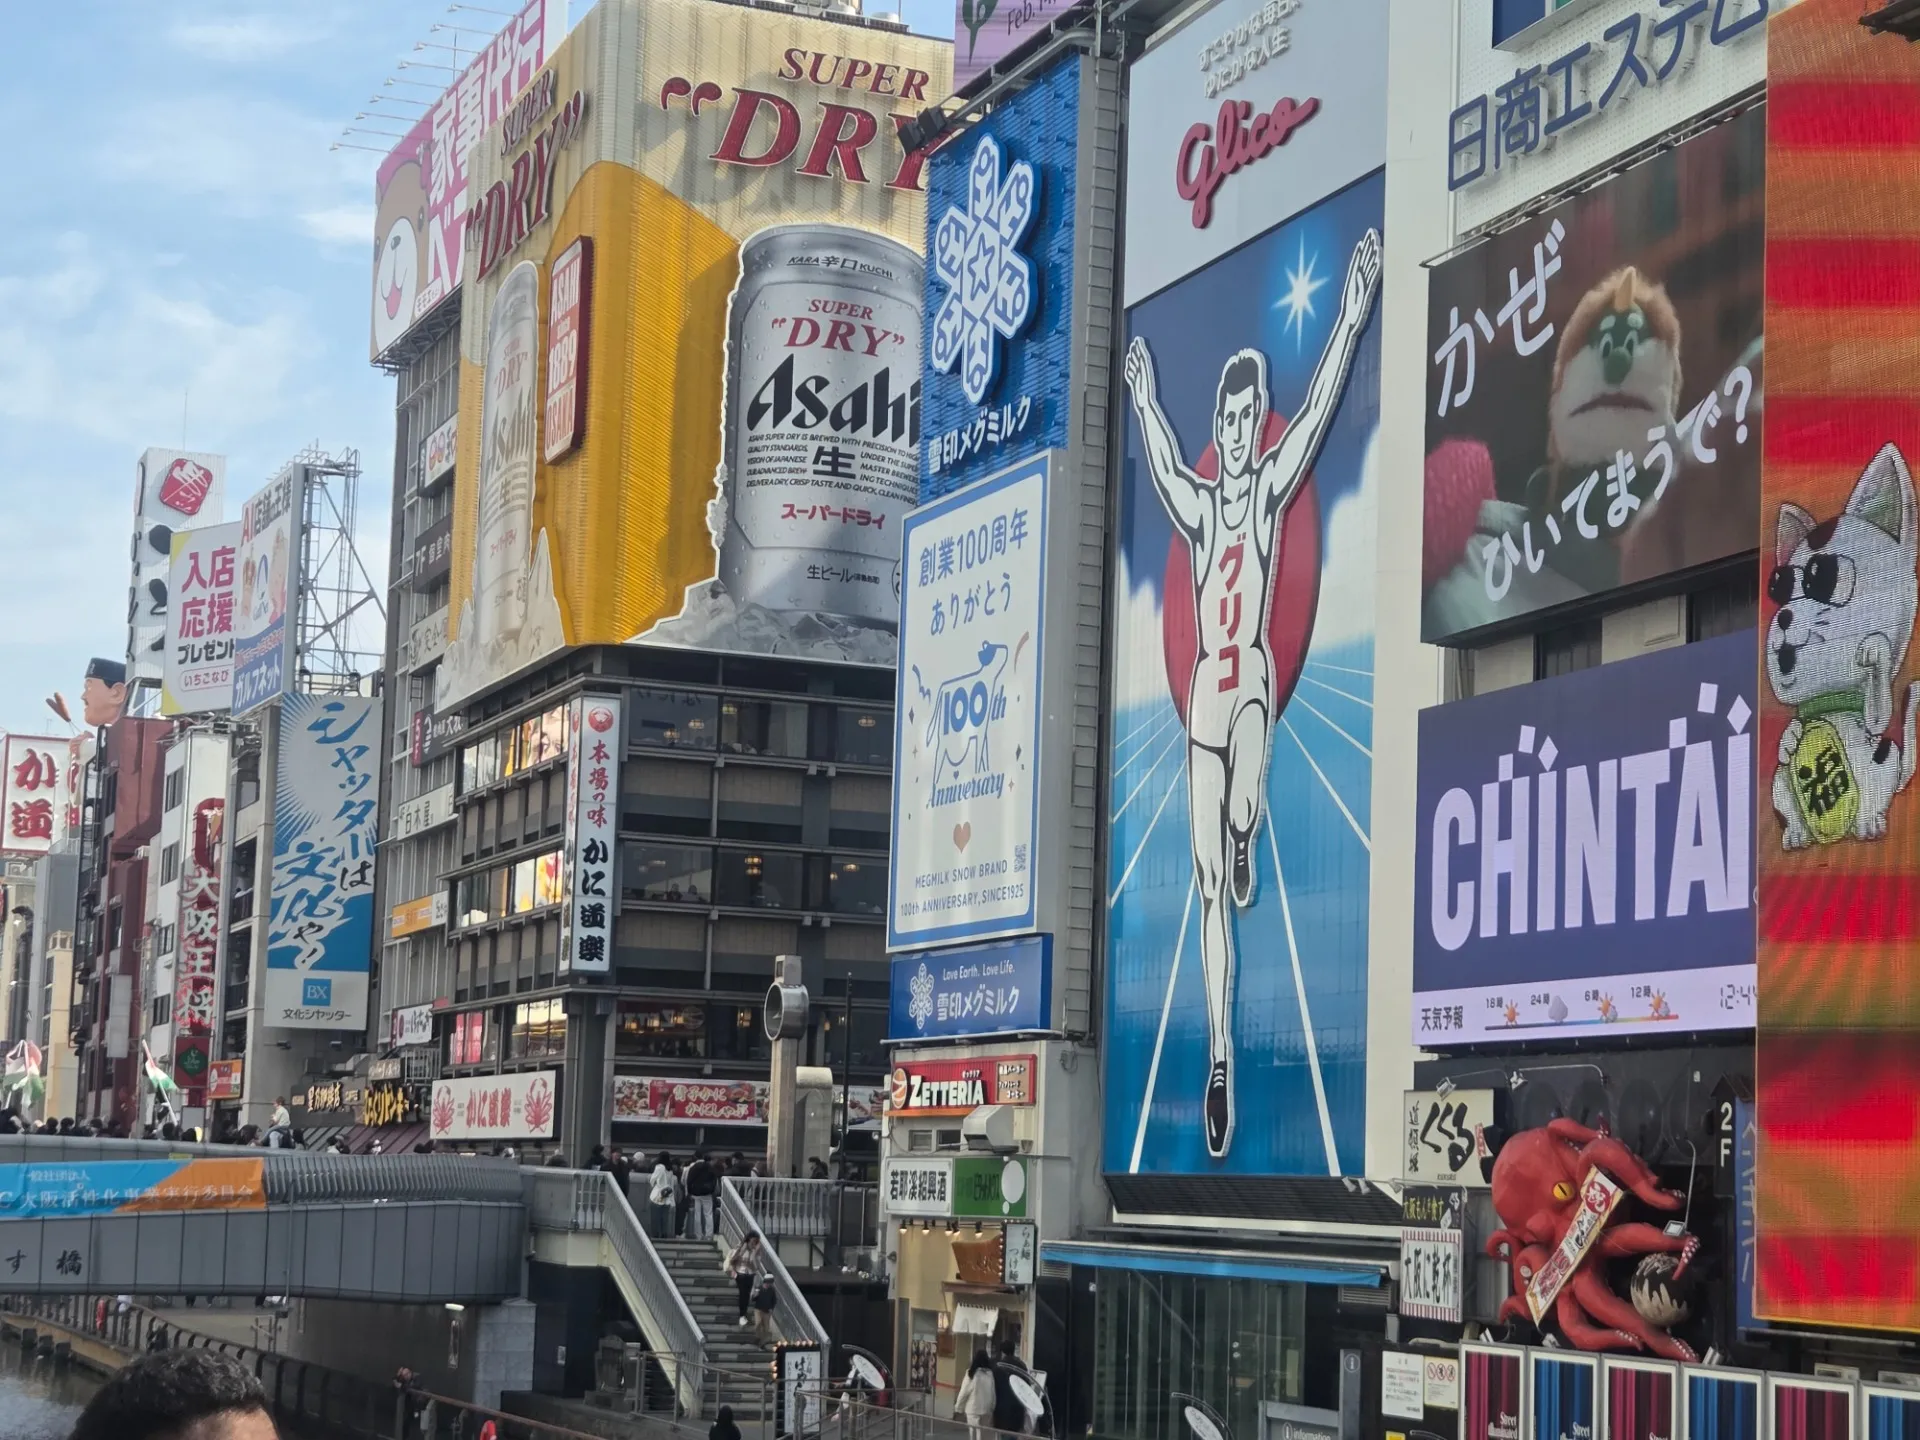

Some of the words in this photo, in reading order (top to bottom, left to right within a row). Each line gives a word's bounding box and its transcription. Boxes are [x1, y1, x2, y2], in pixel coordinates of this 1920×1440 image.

[1008, 0, 1035, 36] Feb.
[778, 47, 930, 101] SUPER
[1205, 26, 1290, 98] ゆたかな人生
[501, 68, 556, 156] SUPER
[1176, 97, 1319, 229] Glico
[787, 256, 820, 266] KARA
[821, 255, 858, 271] 辛口
[859, 263, 893, 280] KUCHI
[550, 255, 581, 328] ASAHI
[808, 299, 873, 320] SUPER
[1434, 218, 1566, 417] かぜ
[548, 329, 578, 394] 1889
[545, 387, 576, 449] OSAKA
[747, 353, 920, 448] Asahi
[786, 433, 801, 441] DRY
[810, 434, 840, 443] BREWED
[842, 437, 861, 446] WITH
[862, 441, 897, 453] PRECISION
[929, 395, 1031, 474] 雪印メグミルク
[812, 445, 856, 480] 生
[860, 451, 886, 462] UNDER
[887, 457, 901, 467] THE
[860, 463, 891, 475] MASTER
[811, 480, 833, 488] TASTE
[834, 482, 852, 490] AND
[781, 503, 886, 529] スーパードライ
[181, 546, 236, 593] 入店
[919, 508, 1029, 587] 創業100周年
[807, 564, 853, 583] 生ビール
[179, 591, 236, 640] 応援
[931, 572, 1011, 636] ありがとう
[1217, 532, 1247, 693] グリコ
[178, 638, 234, 665] プレゼント
[235, 653, 280, 709] ガルフネット
[587, 740, 610, 828] 本場の味
[926, 773, 1004, 808] Anniversary
[405, 800, 431, 834] 白木屋
[1431, 692, 1752, 951] CHINTAI
[915, 871, 949, 888] MEGMILK
[952, 865, 976, 882] SNOW
[979, 860, 1007, 877] BRAND
[579, 837, 608, 962] かに道楽
[901, 901, 919, 916] 100th
[178, 866, 220, 1027] 大阪王将
[306, 983, 327, 1000] BX
[943, 967, 958, 981] Love
[959, 964, 980, 978] Earth.
[983, 963, 998, 977] Love
[1000, 959, 1015, 975] Life.
[937, 984, 1019, 1021] 雪印メグミルク
[1421, 1005, 1463, 1031] 天気予報
[466, 1087, 511, 1128] かに道楽
[910, 1075, 984, 1107] ZETTERIA
[1420, 1102, 1475, 1172] くくる
